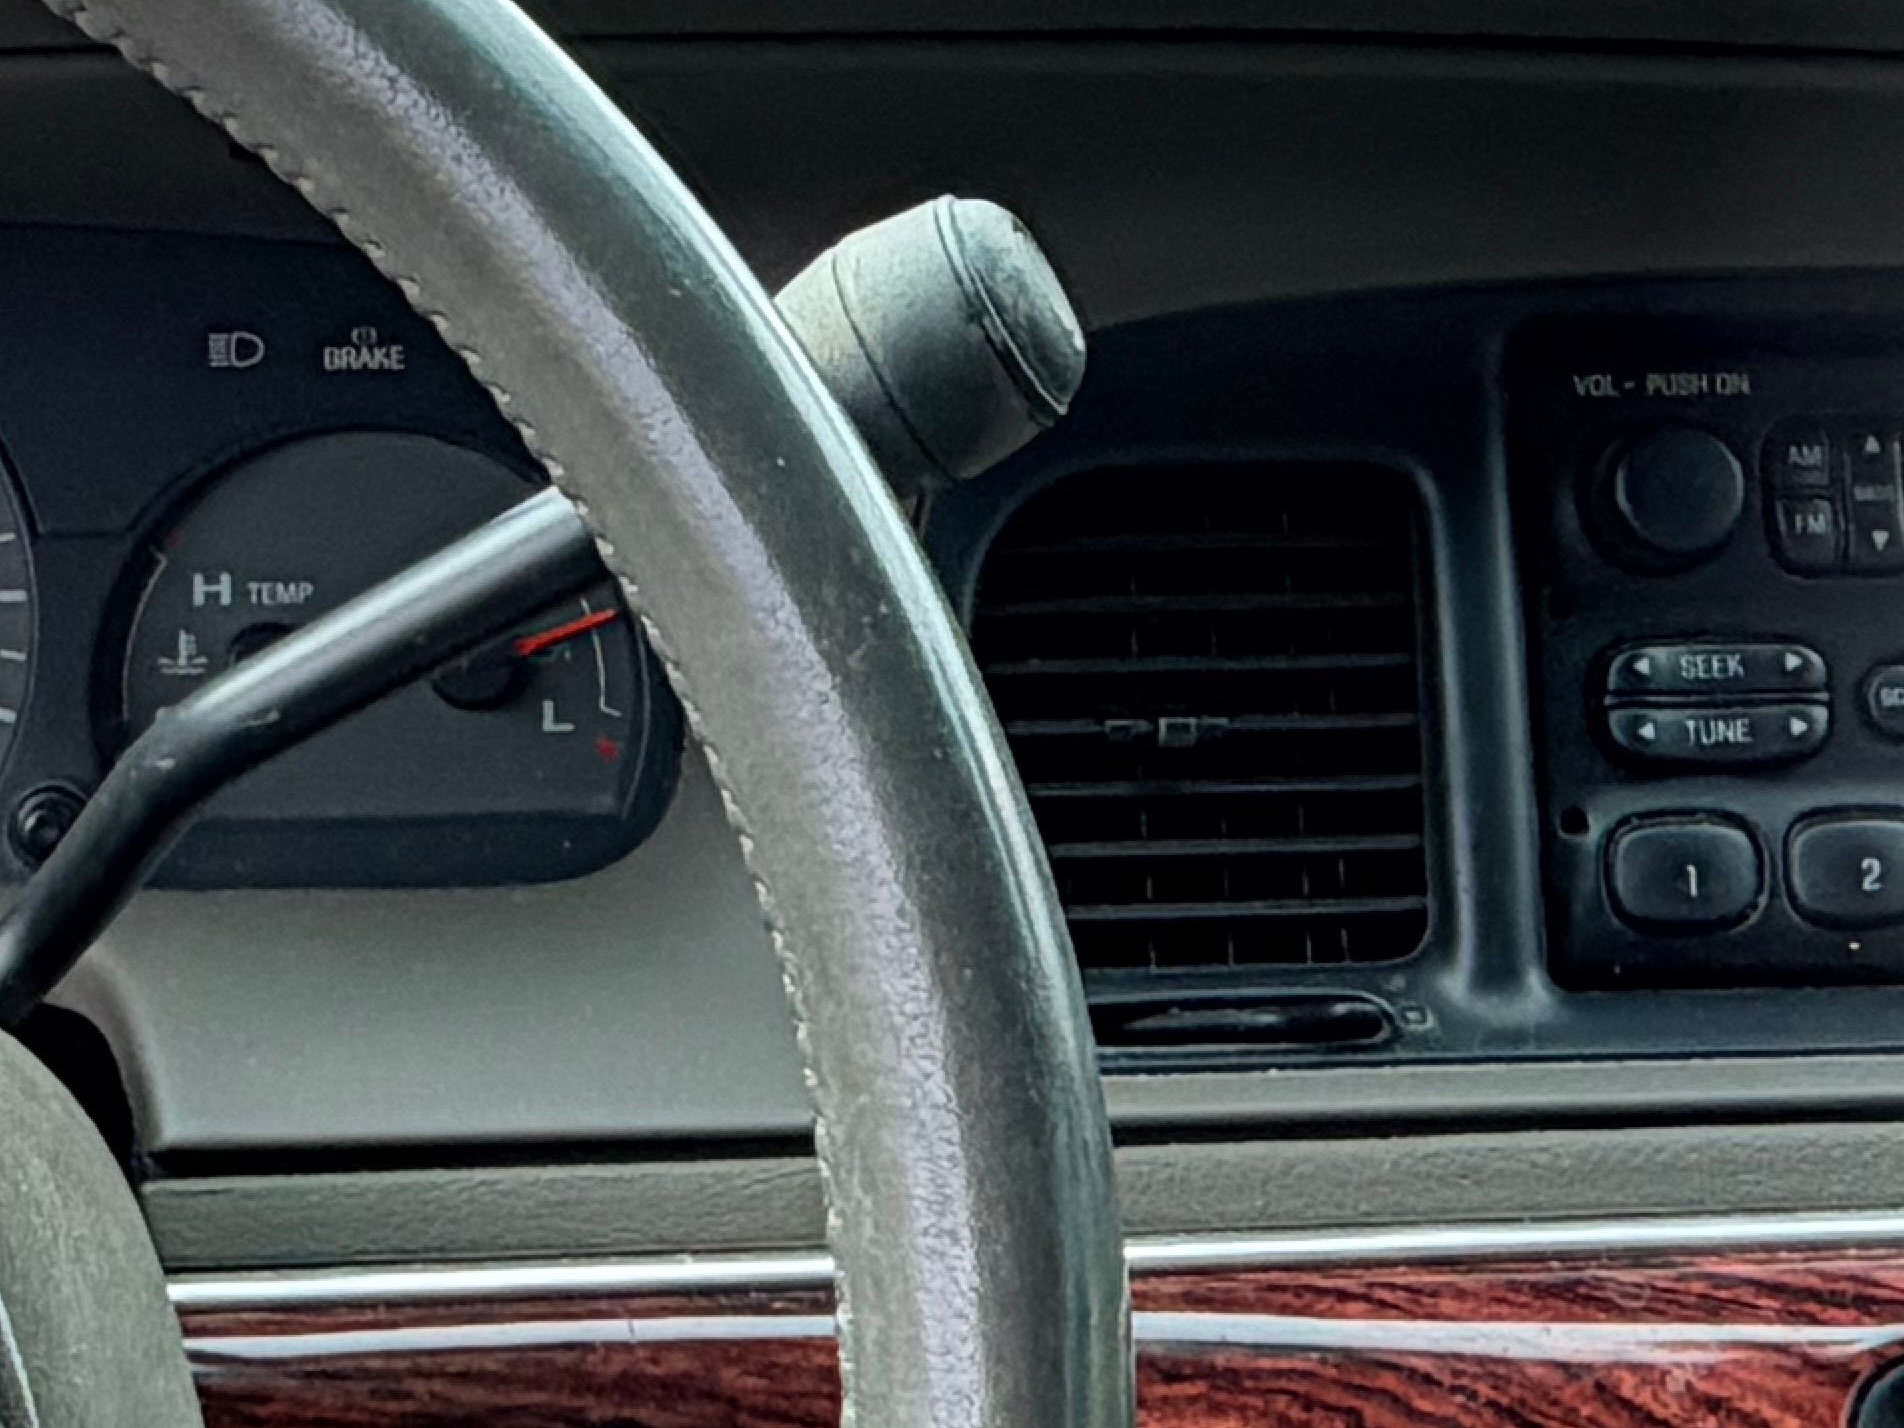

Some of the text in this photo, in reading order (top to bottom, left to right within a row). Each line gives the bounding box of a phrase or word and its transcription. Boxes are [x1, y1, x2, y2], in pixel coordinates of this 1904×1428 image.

[324, 345, 404, 370] BRAKE
[1573, 376, 1619, 395] VOL
[1647, 373, 1707, 393] PUSH
[1715, 373, 1750, 393] ON
[194, 574, 313, 605] H TEMP
[1680, 655, 1744, 678] SEEK
[543, 701, 574, 731] L
[1686, 719, 1752, 744] TUNE
[1687, 864, 1698, 897] 1
[1862, 858, 1881, 890] 2
